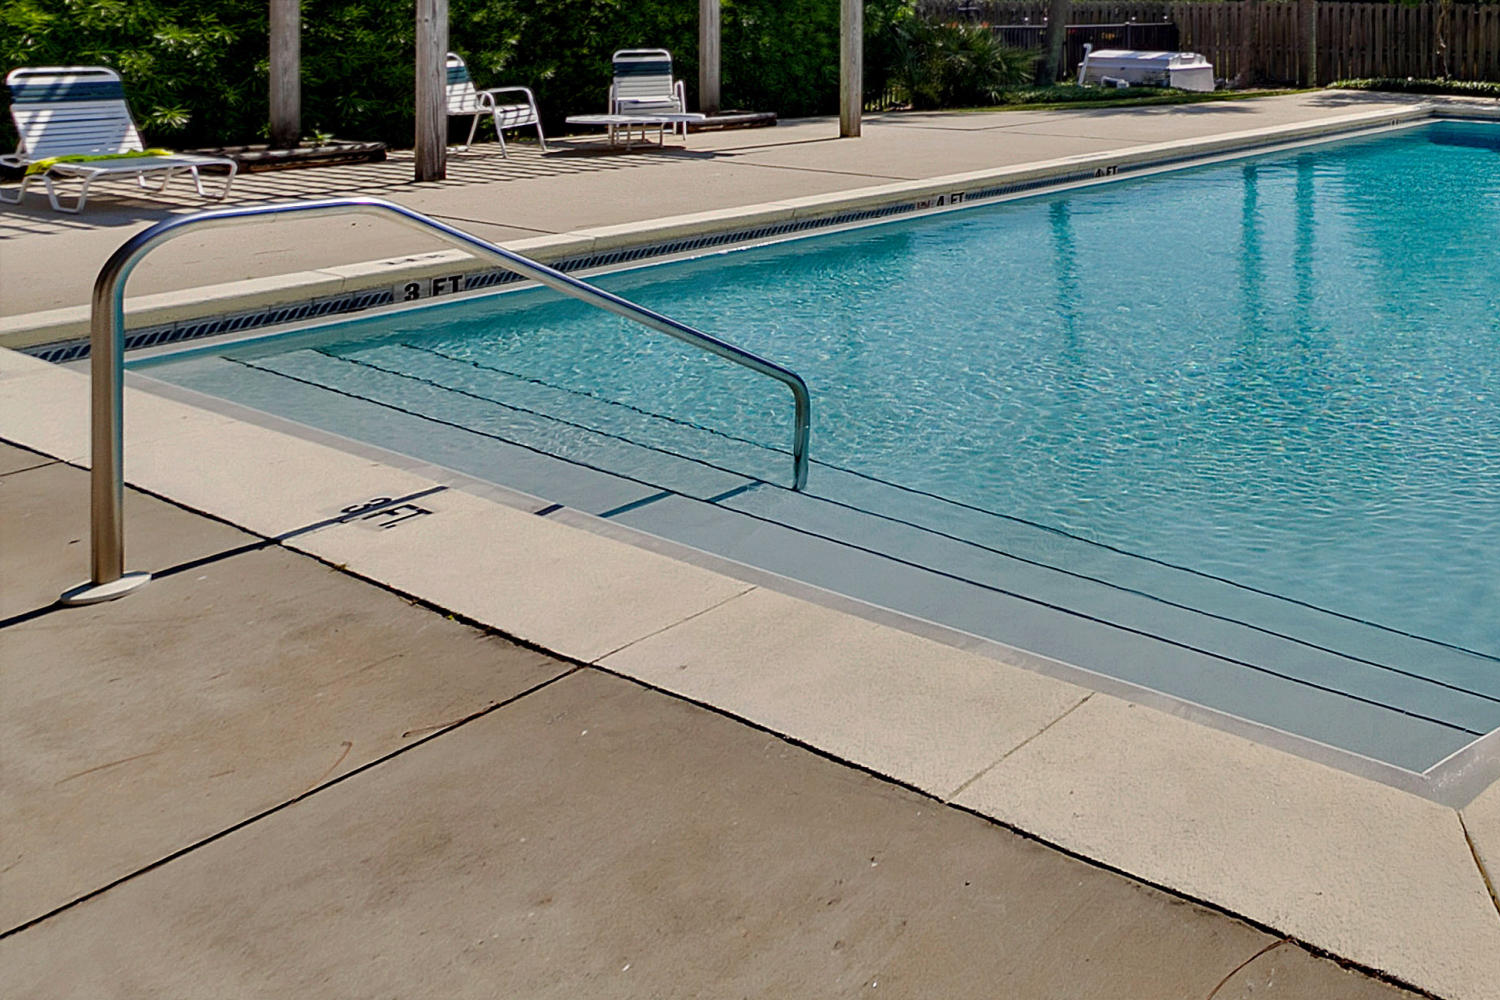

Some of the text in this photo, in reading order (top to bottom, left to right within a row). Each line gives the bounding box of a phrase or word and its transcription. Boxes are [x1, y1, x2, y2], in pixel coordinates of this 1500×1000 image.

[1106, 165, 1118, 176] FT
[951, 191, 965, 204] FT
[404, 275, 464, 301] 3 FT
